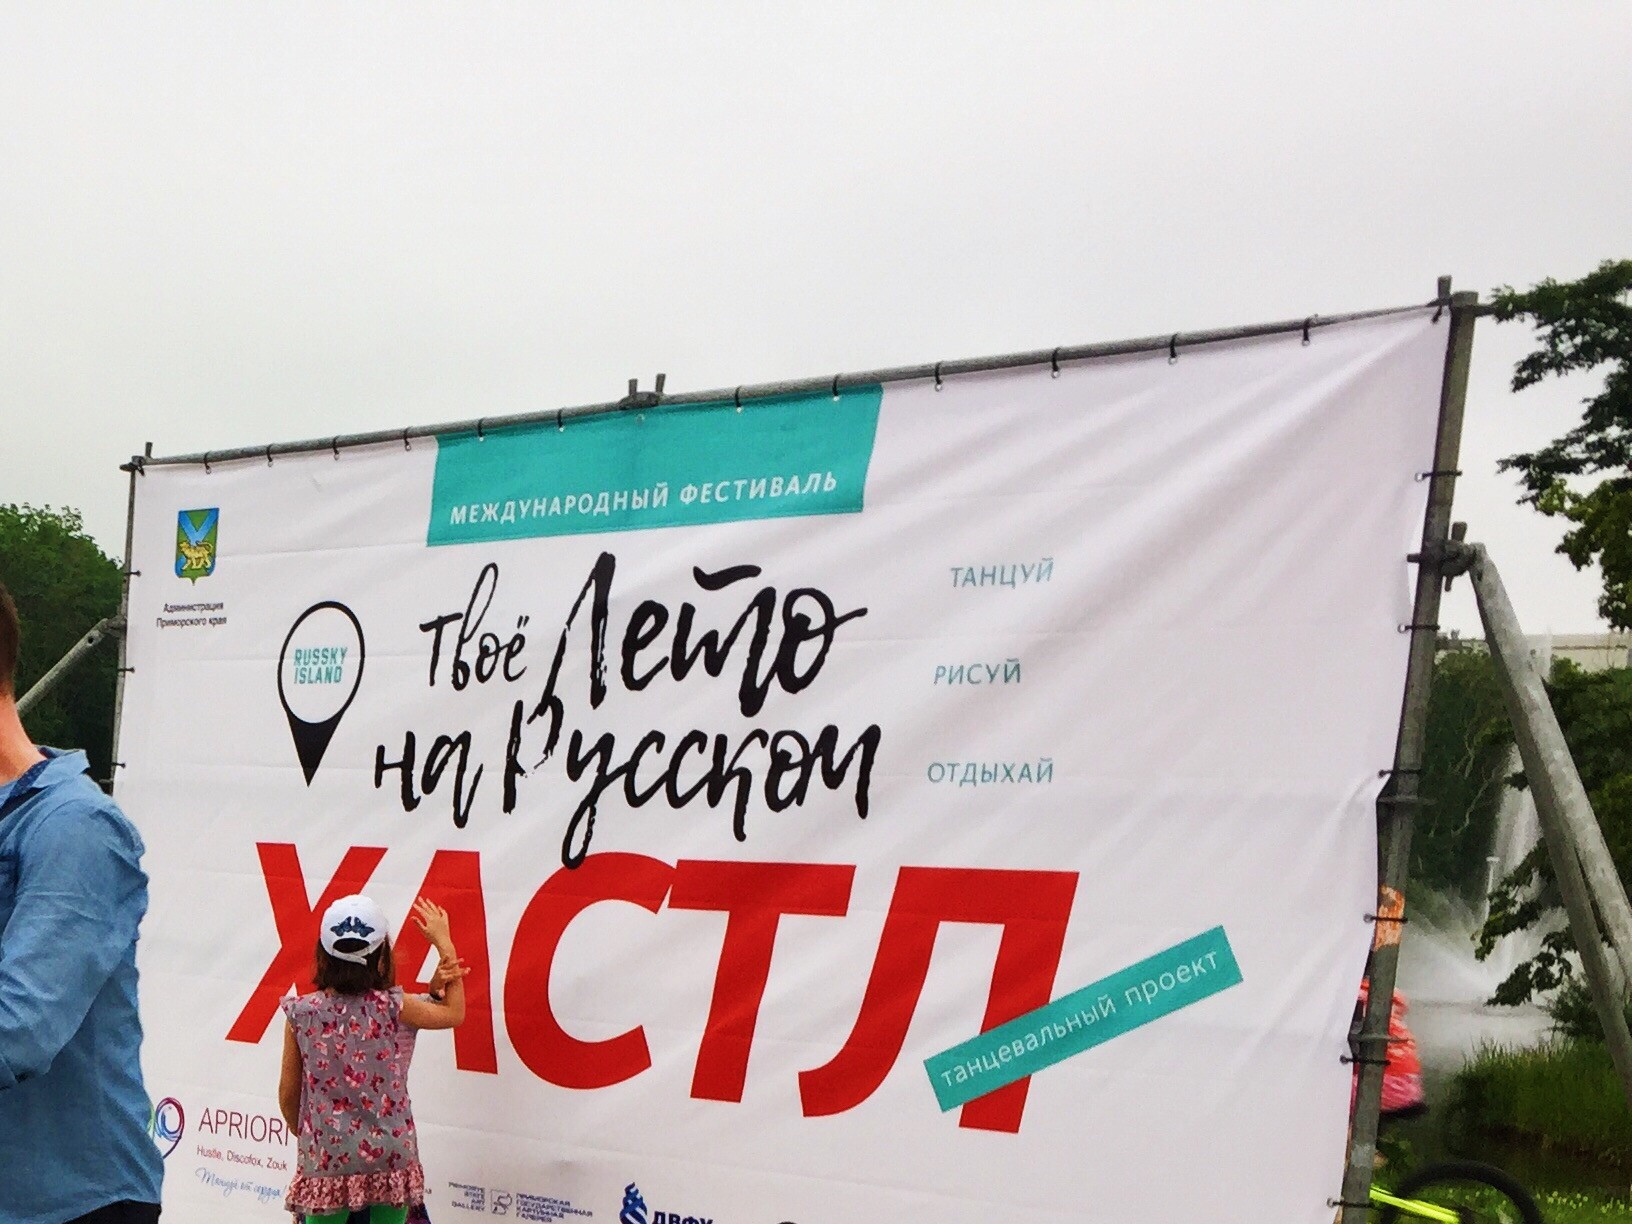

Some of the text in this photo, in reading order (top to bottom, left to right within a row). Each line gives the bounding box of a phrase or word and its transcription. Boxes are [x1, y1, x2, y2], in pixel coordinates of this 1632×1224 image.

[450, 471, 838, 525] МЕЖДУНАРОДНЫЙ ФЕСТИВАЛЬ
[950, 557, 1054, 589] ТАНЦУЙ
[419, 551, 868, 724] Твоё Лето
[294, 647, 348, 666] RUSSKY
[934, 657, 1021, 685] РИСУЙ
[293, 666, 343, 685] ISLAND
[374, 695, 881, 870] на Русском
[926, 757, 1054, 788] ОТДЫХАЙ
[225, 842, 1079, 1134] ХАСТЛ
[940, 949, 1219, 1088] танцевальный проект
[198, 1107, 289, 1147] APRIORI
[266, 1157, 288, 1171] Zouk
